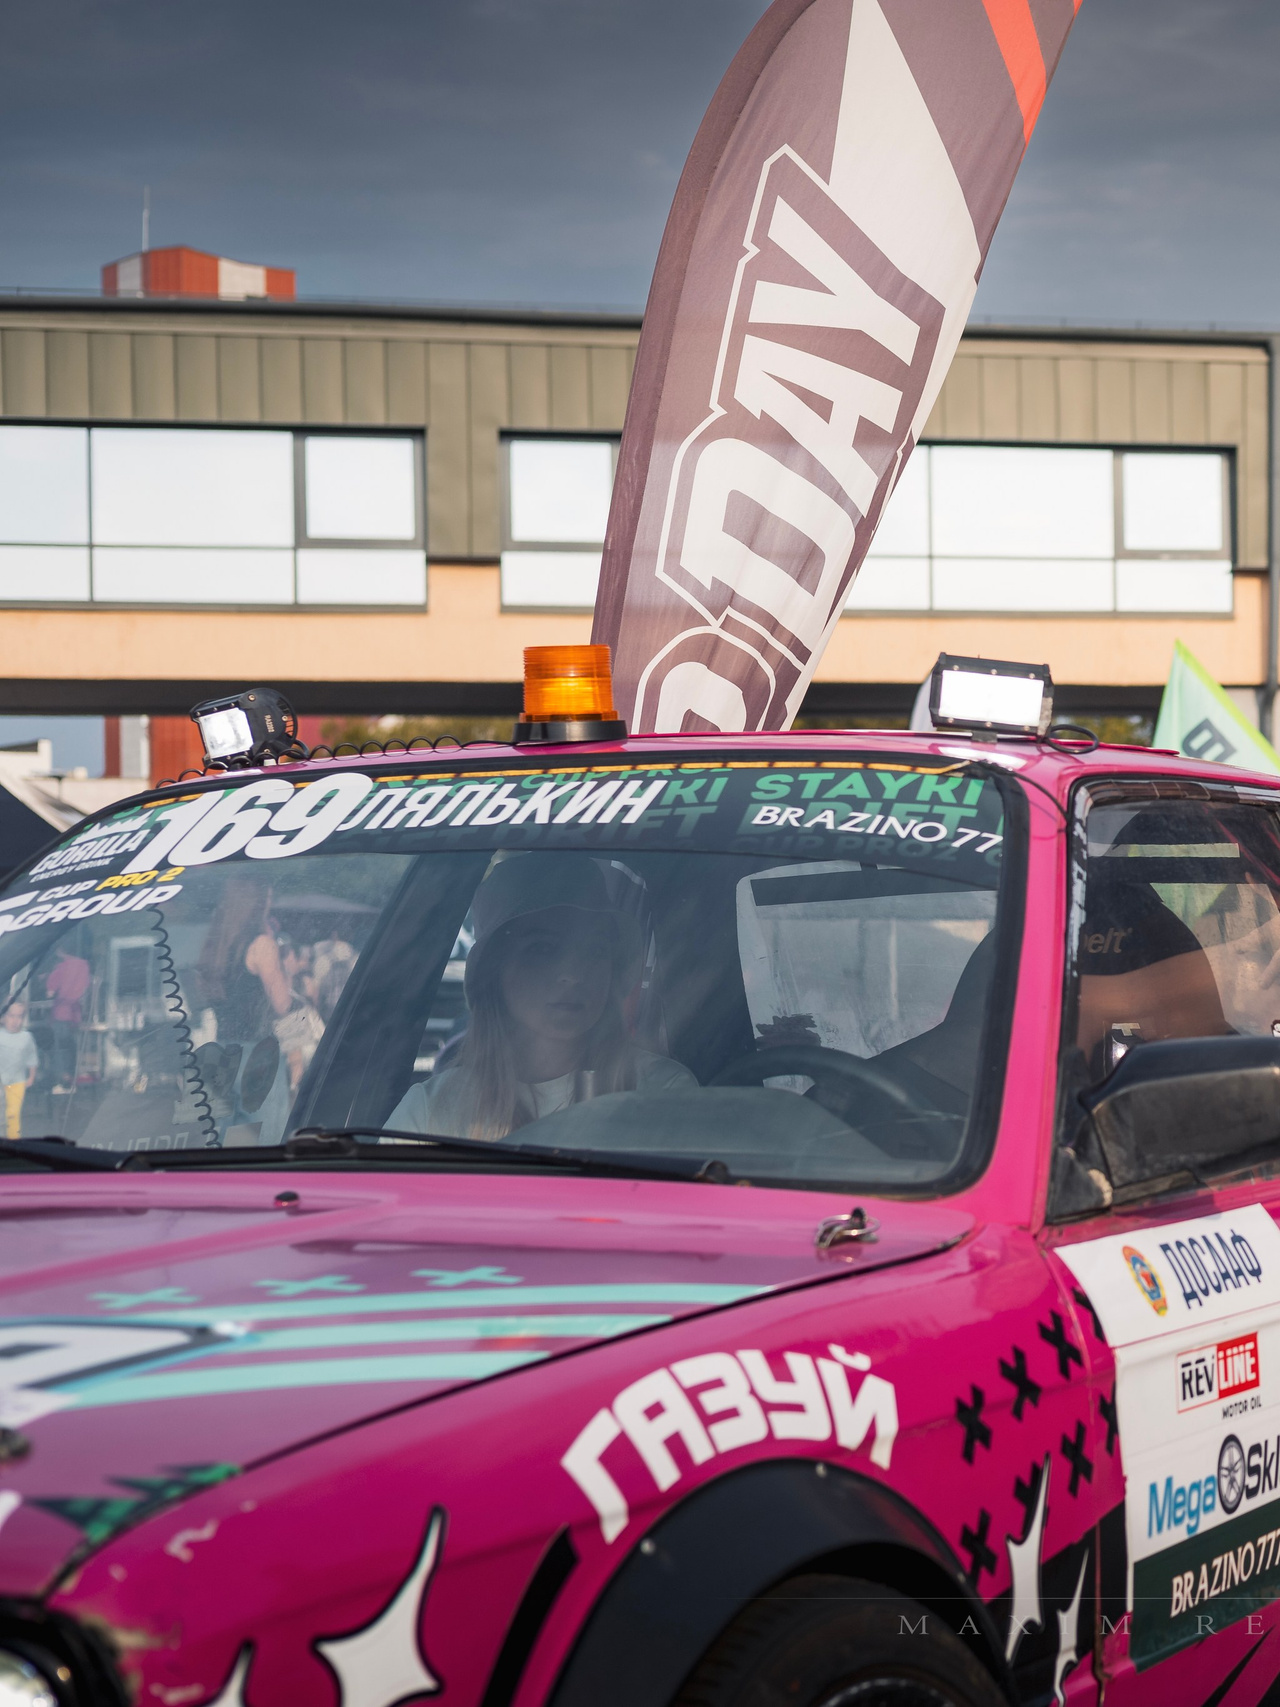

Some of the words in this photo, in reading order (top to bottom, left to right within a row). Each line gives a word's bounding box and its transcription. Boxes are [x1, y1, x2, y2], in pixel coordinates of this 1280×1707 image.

[338, 780, 668, 831] ЛЯЛЬКИН
[751, 772, 985, 805] STAYKI
[120, 773, 374, 874] 169
[751, 805, 1003, 853] BRAZINO77
[29, 829, 151, 876] GORILLA
[30, 864, 76, 883] ENERGY
[76, 856, 115, 872] DRINK
[37, 880, 98, 902] CUP
[95, 870, 159, 891] PRO
[157, 867, 186, 883] 2
[1160, 1228, 1262, 1309] ДОСААФ
[1222, 1400, 1249, 1419] MOTOR
[1249, 1395, 1262, 1410] OIL
[561, 1343, 899, 1544] ГАЗУЙ
